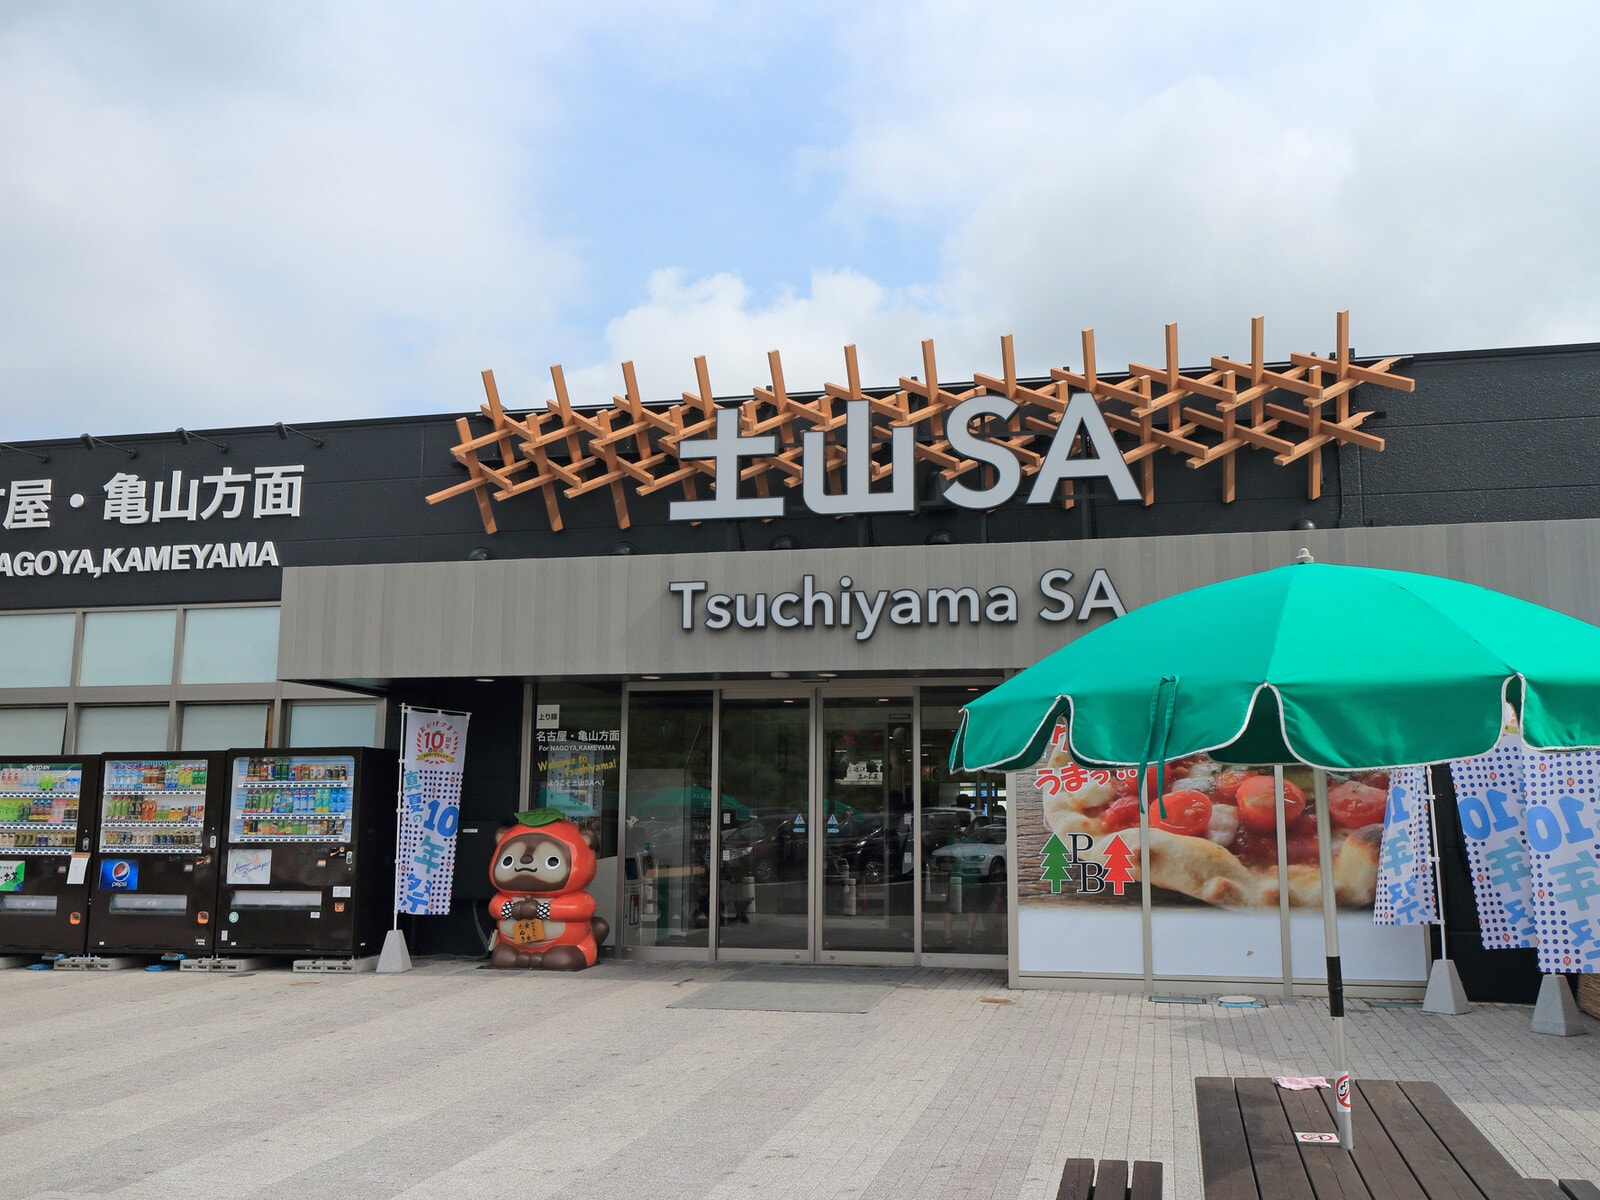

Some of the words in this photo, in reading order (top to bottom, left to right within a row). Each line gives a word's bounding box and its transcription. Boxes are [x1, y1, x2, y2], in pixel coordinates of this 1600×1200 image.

[0, 464, 305, 530] 屋・亀山方面
[669, 575, 1018, 642] Tsuchiyama
[1038, 568, 1127, 622] SA
[536, 730, 620, 742] 名古屋・亀山方面
[537, 757, 576, 772] Welcome
